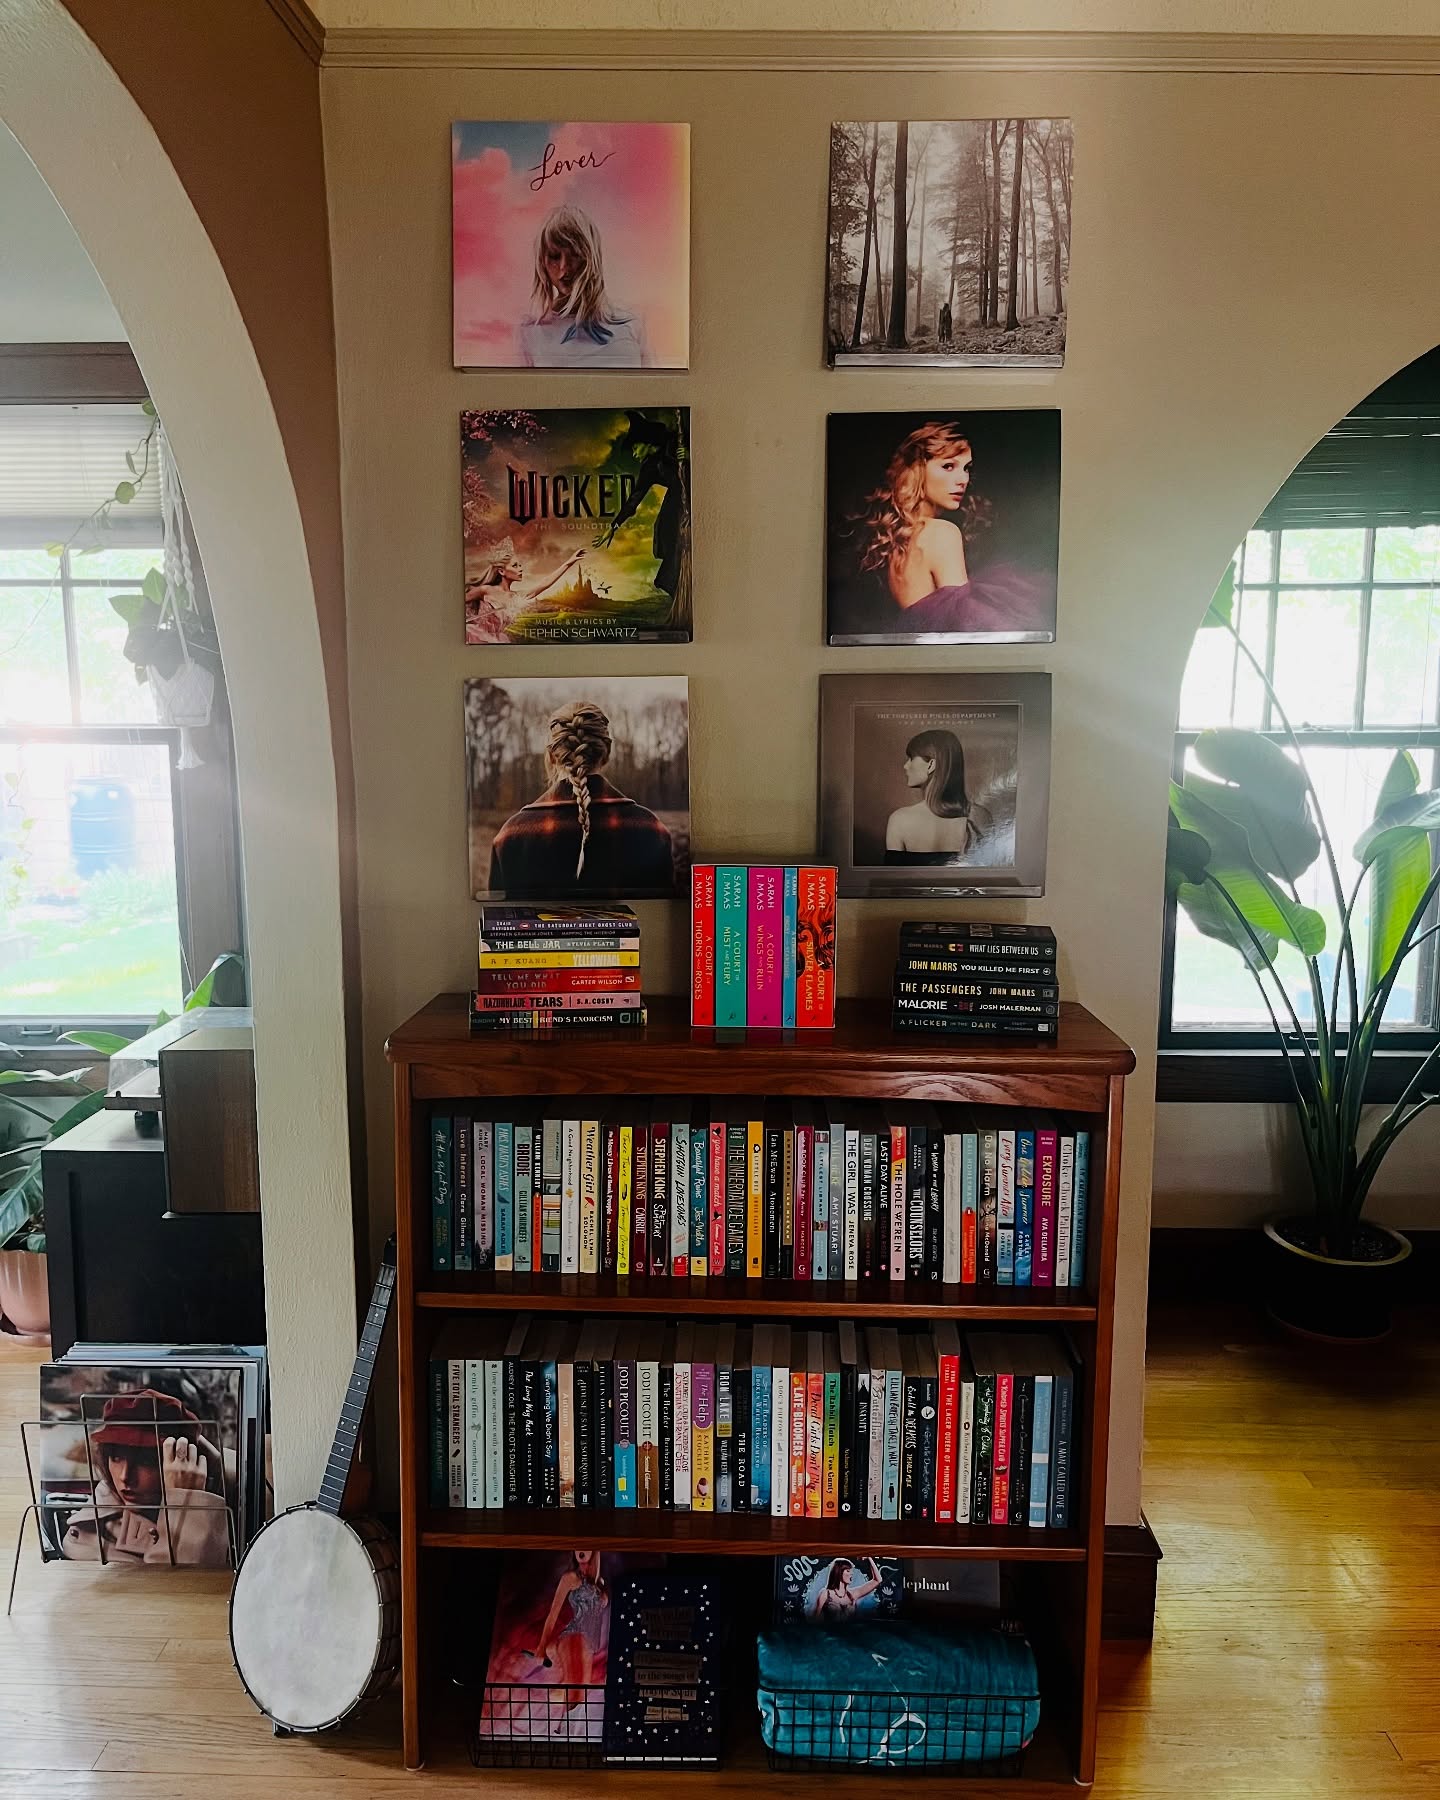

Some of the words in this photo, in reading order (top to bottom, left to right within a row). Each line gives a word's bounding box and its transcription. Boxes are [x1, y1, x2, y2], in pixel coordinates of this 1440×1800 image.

[528, 143, 616, 191] Lover
[507, 462, 637, 525] WICKED
[522, 628, 569, 638] TEPHEN
[571, 628, 639, 637] SCHWARTZ
[695, 920, 703, 954] THORNS
[756, 925, 764, 955] WINGS
[969, 944, 986, 952] WHAT
[987, 945, 1000, 954] LIES
[1002, 946, 1029, 955] BETWEEN
[1030, 948, 1039, 956] US
[723, 962, 731, 985] FURY
[908, 960, 928, 970] JOHN
[930, 961, 958, 971] MARRS
[900, 982, 917, 992] THE
[922, 983, 982, 995] PASSENGERS
[989, 987, 1006, 995] JOHN
[1010, 988, 1035, 997] MARRS
[483, 998, 526, 1007] RAZORBLADE
[530, 997, 563, 1007] TEARS
[898, 1000, 948, 1009] MALORIE
[972, 1021, 997, 1029] DARK
[585, 1127, 595, 1171] Weather
[712, 1139, 721, 1154] you
[729, 1144, 744, 1160] THE
[848, 1138, 856, 1157] THE
[863, 1138, 872, 1156] DEAD
[985, 1135, 992, 1149] Do
[1001, 1138, 1012, 1163] Every
[517, 1144, 530, 1176] BRODIE
[636, 1147, 645, 1180] STEPHEN
[655, 1138, 666, 1174] STEPHEN
[676, 1136, 687, 1177] SHOTGUN
[692, 1141, 705, 1175] Beautiful
[985, 1152, 992, 1165] No
[1062, 1144, 1072, 1177] Choke
[583, 1174, 595, 1193] Girl
[848, 1161, 856, 1183] GIRL
[863, 1159, 872, 1184] WOMAN
[880, 1165, 888, 1182] DAY
[895, 1163, 903, 1181] THE
[984, 1168, 992, 1196] Harm
[1001, 1163, 1012, 1196] Summer
[1042, 1155, 1053, 1207] EXPOSURE
[636, 1182, 645, 1199] KING
[654, 1176, 665, 1199] KING
[729, 1164, 744, 1219] INHERITANCE
[675, 1181, 686, 1227] LOVESONGS
[847, 1192, 856, 1215] WAS
[863, 1187, 872, 1221] CROSSING
[636, 1208, 645, 1234] CARRIE
[894, 1211, 902, 1240] WE'RE
[909, 1200, 924, 1259] COUNSELORS
[728, 1222, 744, 1254] GAMES
[831, 1219, 839, 1254] STUART
[894, 1242, 902, 1252] IN
[618, 1365, 630, 1389] JODI
[640, 1367, 651, 1391] JODI
[719, 1371, 729, 1392] IRON
[522, 1386, 533, 1402] Long
[543, 1374, 552, 1410] Everything
[793, 1387, 803, 1408] LATE
[619, 1393, 630, 1438] PICOULT
[642, 1394, 651, 1439] PICOULT
[698, 1398, 709, 1422] Help
[719, 1398, 729, 1419] LAKE
[810, 1392, 821, 1419] Dead
[793, 1411, 803, 1457] BLOOMERS
[944, 1432, 952, 1452] QUEEN
[544, 1444, 552, 1458] Say
[1057, 1448, 1066, 1465] MAN
[1056, 1467, 1065, 1491] CALLED
[1056, 1494, 1065, 1508] OVE
[903, 1576, 950, 1592] lephant
